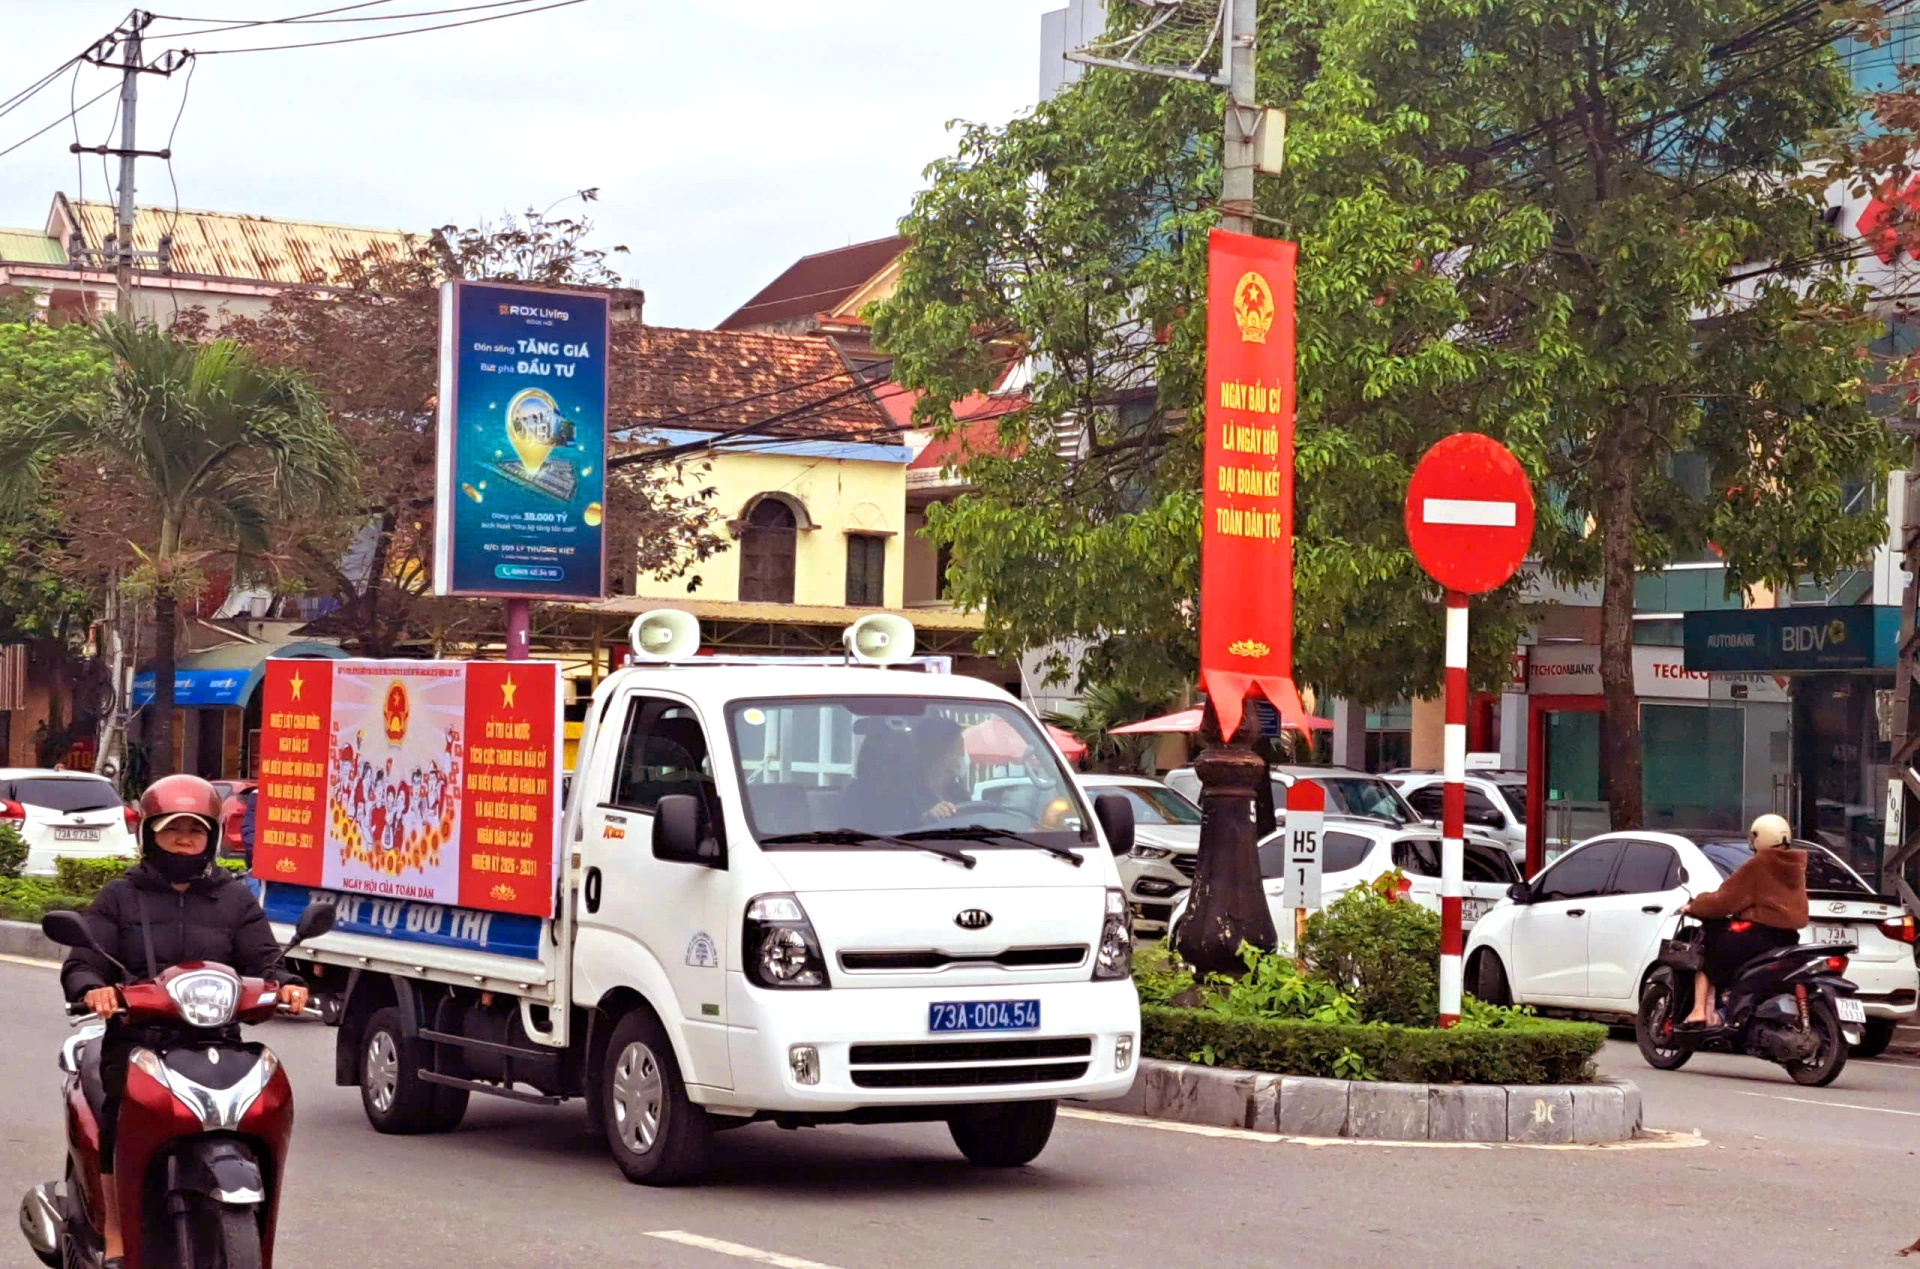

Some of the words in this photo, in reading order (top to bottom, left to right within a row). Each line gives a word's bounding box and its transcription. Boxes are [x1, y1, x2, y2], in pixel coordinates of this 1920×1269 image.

[509, 306, 538, 317] ROX
[540, 308, 569, 321] Living
[517, 338, 559, 356] TĂNG
[563, 343, 590, 358] GIÁ
[554, 363, 576, 378] TƯ
[1221, 378, 1247, 411] NGÀY
[1249, 378, 1267, 413] BẦU
[1269, 377, 1281, 414] CỬ
[1223, 419, 1235, 451] LÀ
[1237, 422, 1262, 454] NGÀY
[1263, 424, 1279, 461] HỘI
[1219, 465, 1236, 499] ĐẠI
[1238, 463, 1263, 497] ĐOÀN
[1264, 463, 1281, 497] KẾT
[1216, 504, 1243, 536] TOÀN
[1245, 506, 1263, 538] DÂN
[1265, 507, 1281, 545] TỘC
[519, 630, 526, 645] 1
[1782, 625, 1828, 652] BIDV
[1530, 663, 1595, 677] TECHCOMBANK
[1293, 831, 1317, 854] H5
[450, 908, 493, 947] THỊ
[959, 911, 989, 926] KIA
[1828, 928, 1846, 940] 73A
[932, 1002, 1037, 1030] 73A-004.54
